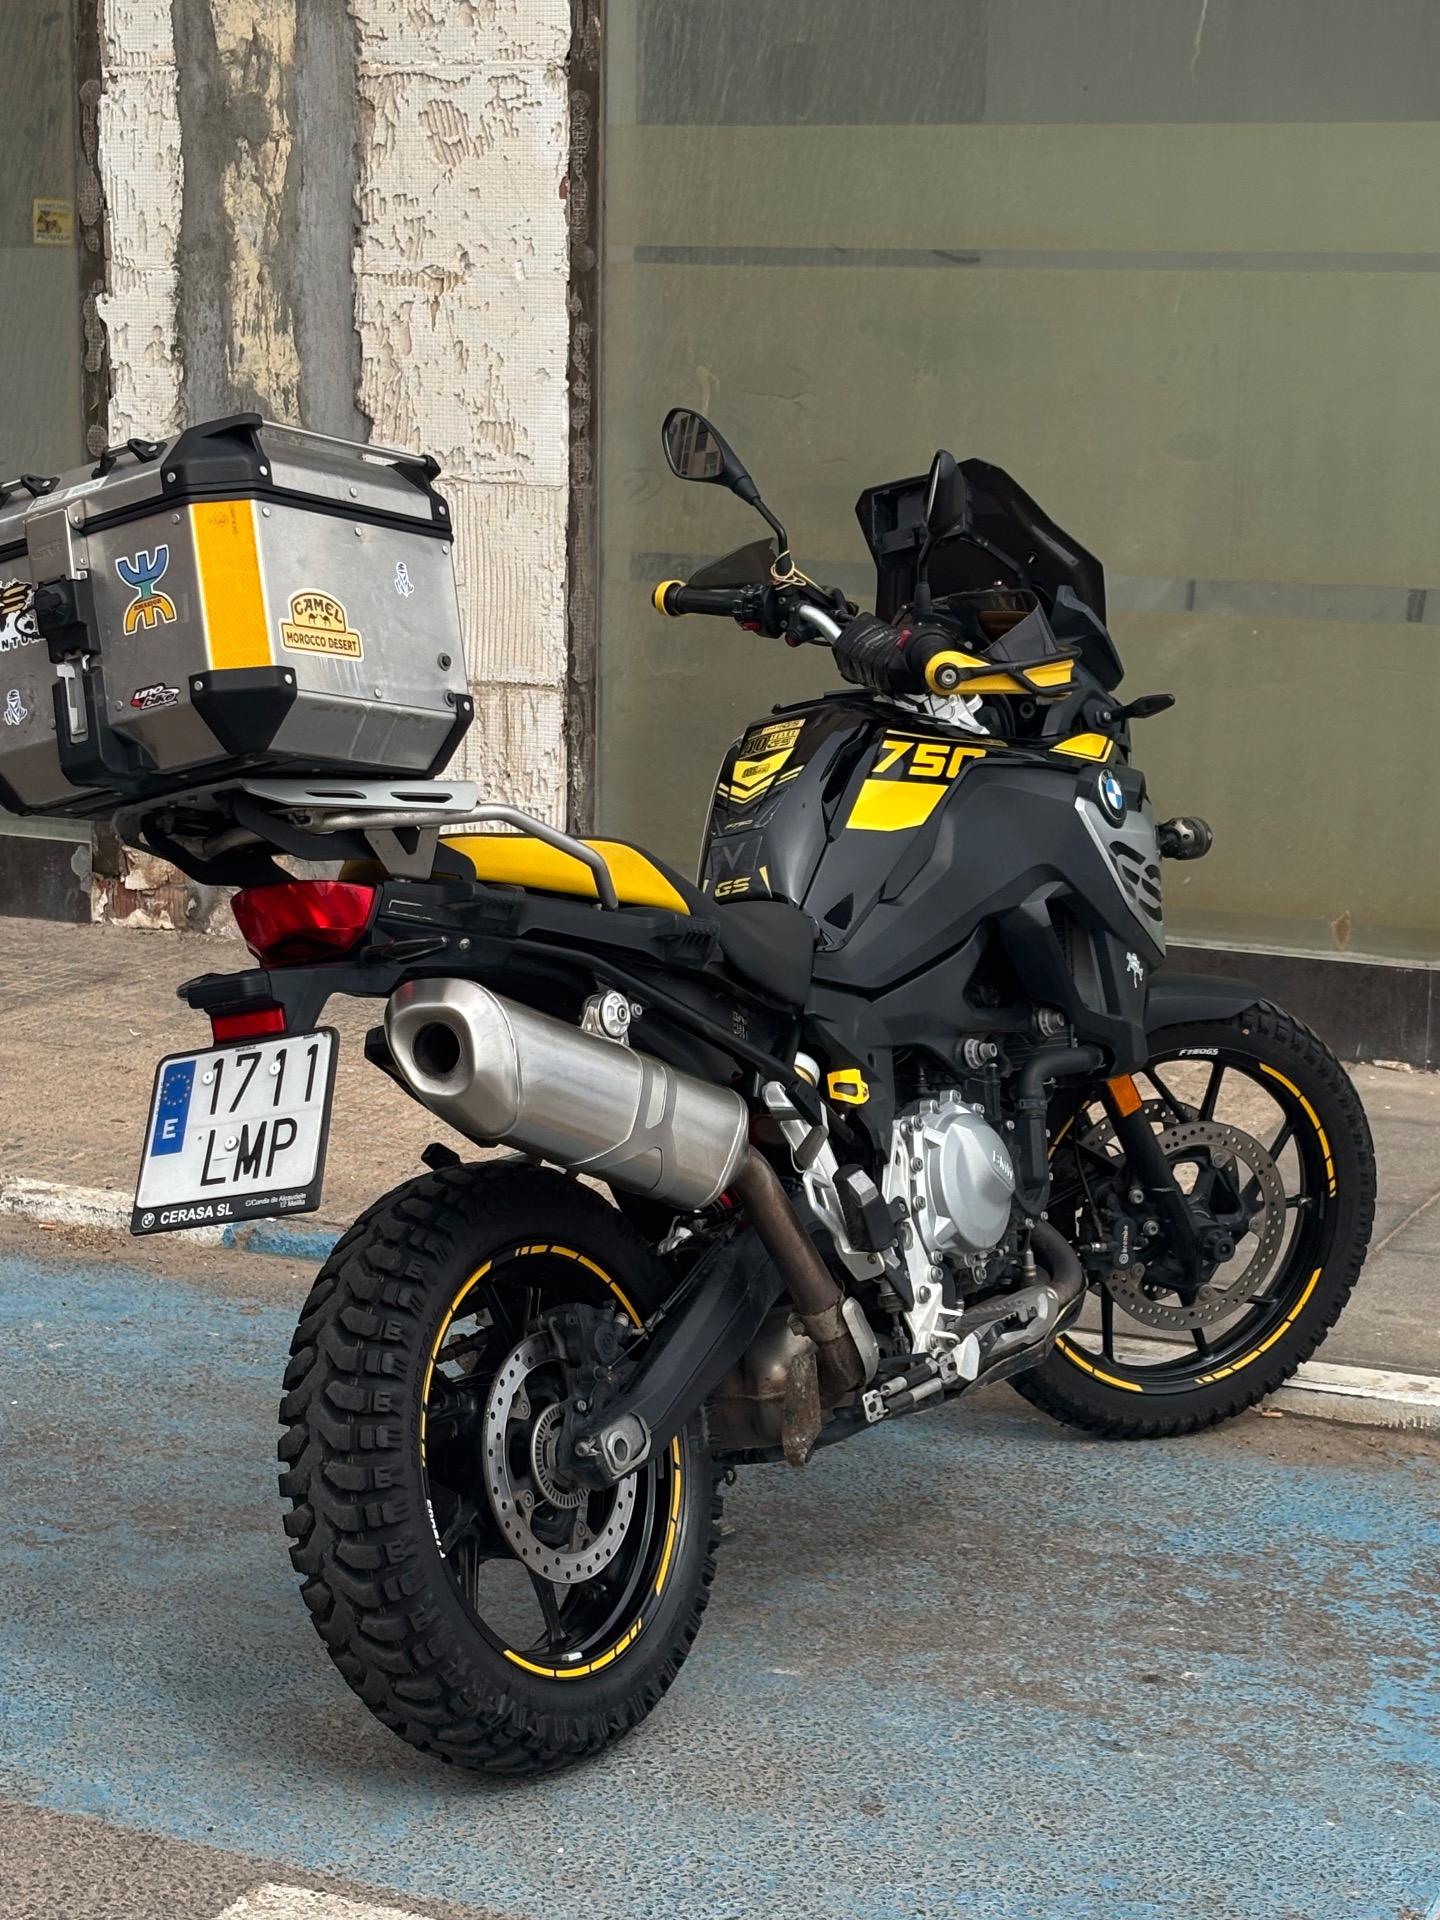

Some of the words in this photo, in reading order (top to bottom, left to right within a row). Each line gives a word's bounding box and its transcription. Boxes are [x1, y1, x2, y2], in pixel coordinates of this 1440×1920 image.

[294, 598, 343, 624] CAMEL
[286, 631, 327, 648] MOROCCO
[328, 637, 358, 652] DESERT
[714, 876, 752, 898] GS
[209, 1043, 320, 1116] 1711
[161, 1118, 179, 1140] E
[199, 1117, 298, 1187] LMP
[160, 1206, 214, 1225] CERASA
[216, 1203, 234, 1218] SL
